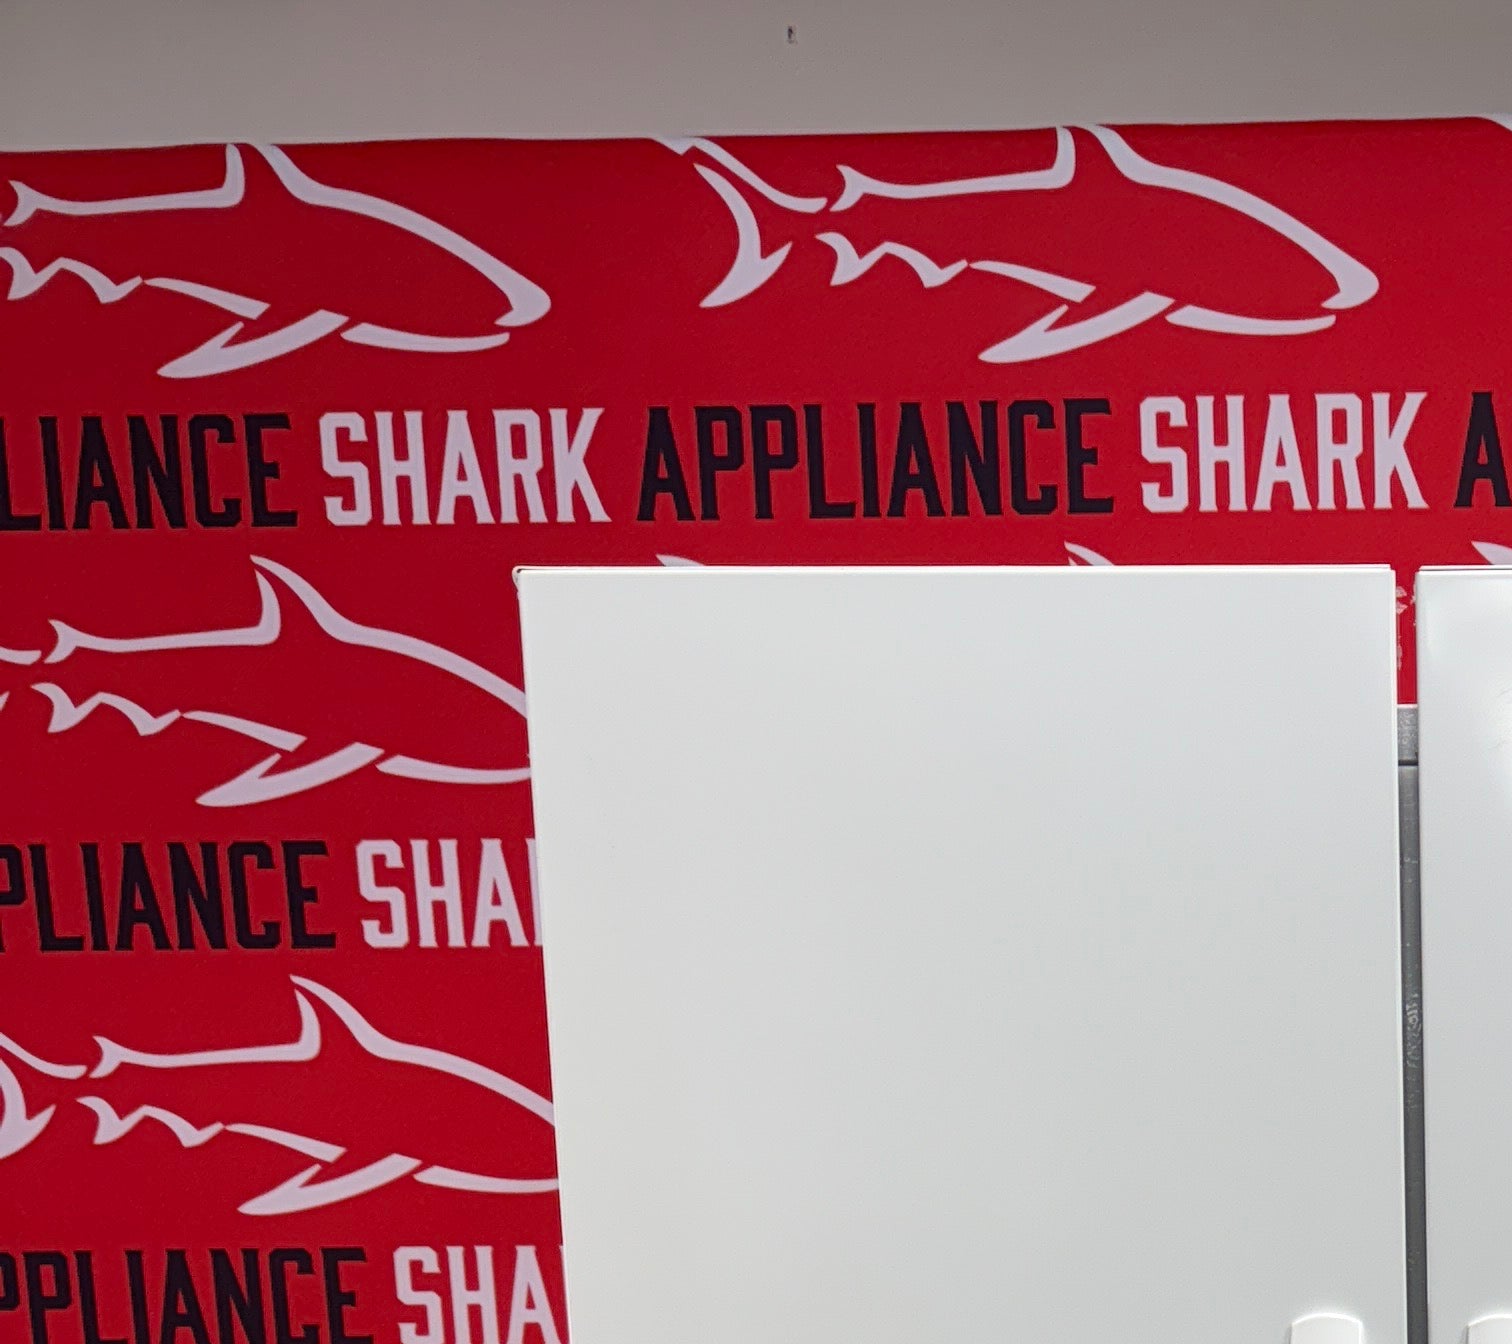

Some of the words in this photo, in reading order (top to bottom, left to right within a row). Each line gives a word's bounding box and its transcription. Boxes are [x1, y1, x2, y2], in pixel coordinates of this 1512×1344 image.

[318, 406, 612, 526] SHARK
[636, 400, 1114, 521] APPLIANCE
[1138, 391, 1430, 513] SHARK
